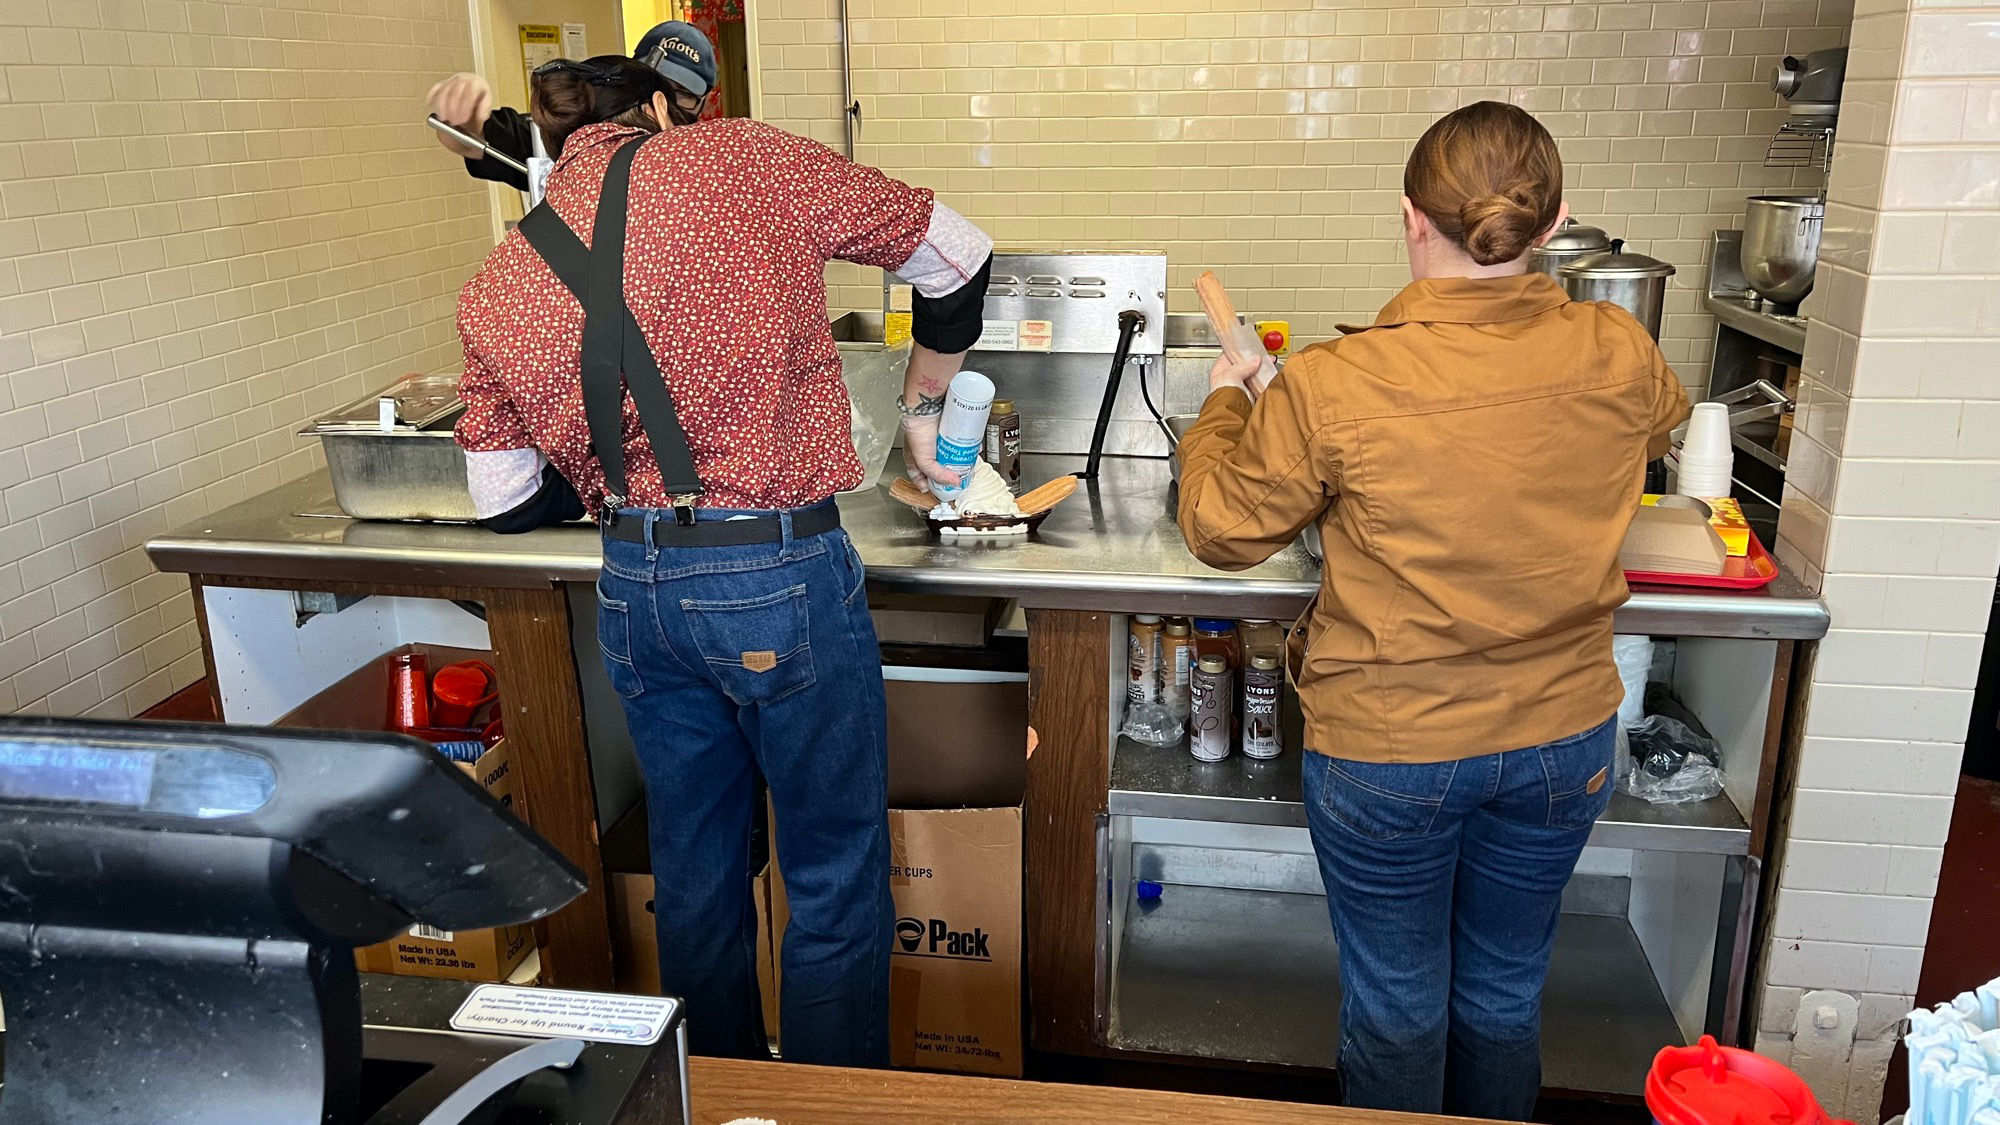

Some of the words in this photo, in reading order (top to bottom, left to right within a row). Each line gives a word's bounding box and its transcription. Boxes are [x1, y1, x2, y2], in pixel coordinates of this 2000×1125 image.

[660, 37, 700, 63] Knott's
[1005, 427, 1020, 438] LYO
[949, 454, 974, 462] Creamy
[1246, 685, 1275, 695] LYONS
[1246, 701, 1273, 714] Sauce
[905, 867, 933, 878] CUPS
[928, 918, 991, 957] Pack
[398, 944, 424, 954] Made
[436, 947, 457, 957] USA
[400, 955, 416, 965] Net
[417, 956, 433, 966] Wt:
[461, 960, 476, 969] lbs
[548, 1022, 585, 1030] Round
[914, 1031, 942, 1041] Made
[957, 1035, 980, 1044] USA
[914, 1041, 931, 1051] Net
[935, 1044, 952, 1053] Wt:
[984, 1048, 1001, 1058] lbs
